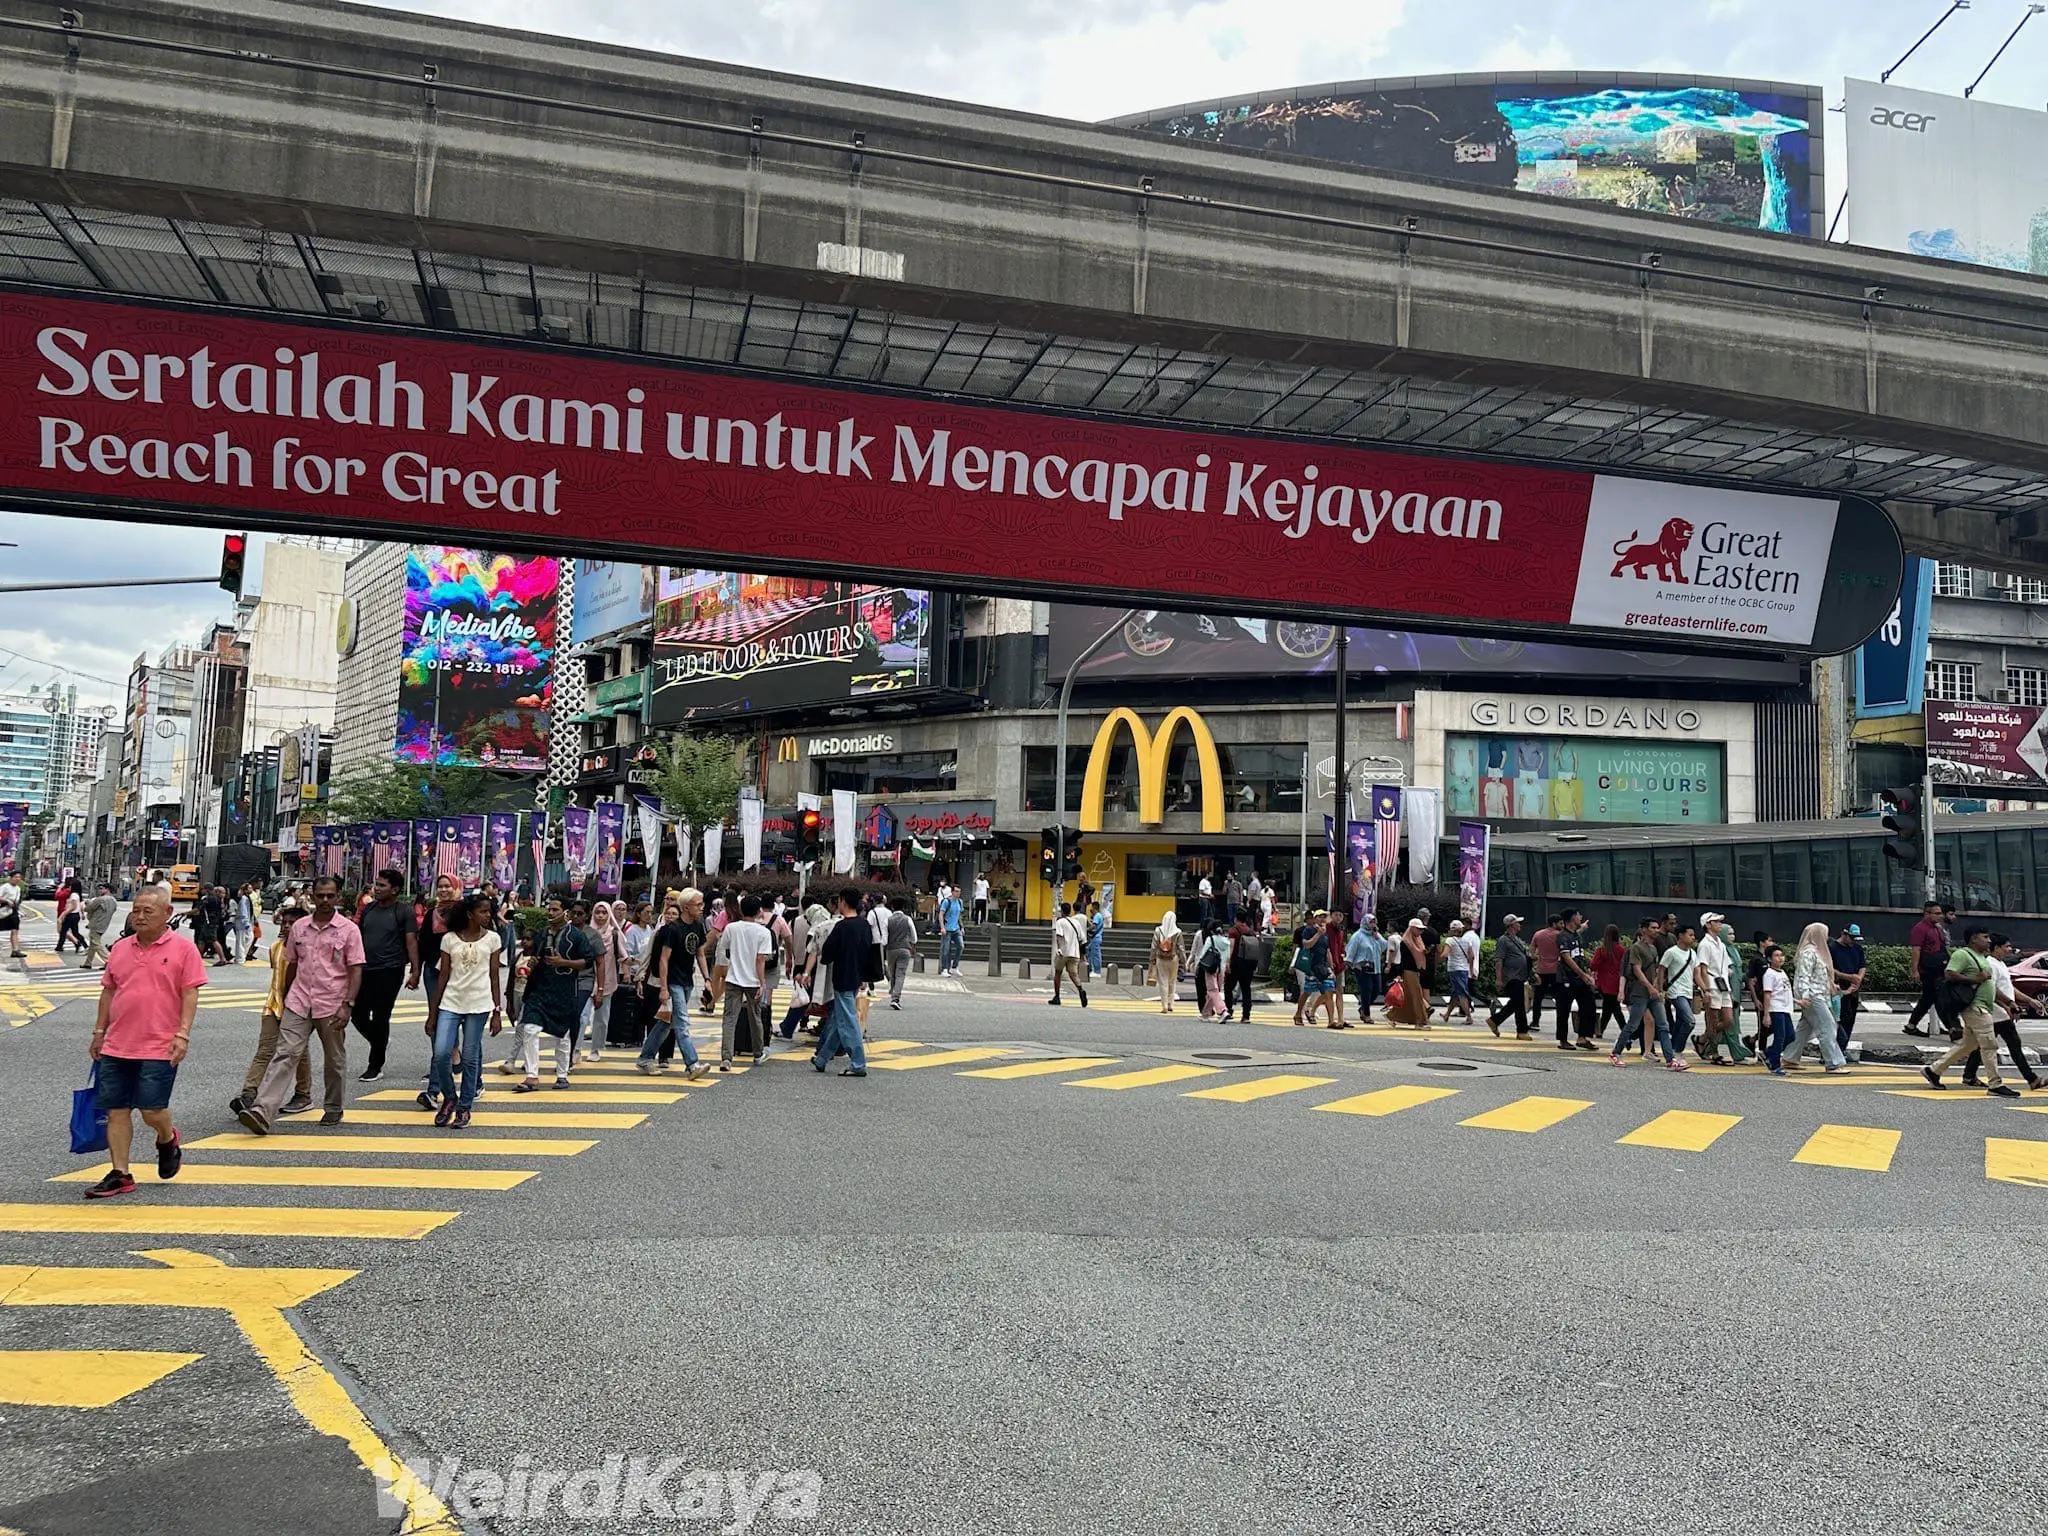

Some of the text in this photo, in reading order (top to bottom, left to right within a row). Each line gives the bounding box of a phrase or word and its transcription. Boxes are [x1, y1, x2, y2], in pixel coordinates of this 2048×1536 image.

[1870, 106, 1936, 133] acer
[37, 326, 1503, 544] Sertailah Kami untuk Mencapai Kejayaan
[38, 415, 562, 516] Reach for Great
[1701, 521, 1783, 559] Great
[1693, 554, 1800, 595] Eastern
[1656, 591, 1796, 614] A member of the OCBC Group
[419, 609, 538, 643] MediaVibe
[1625, 611, 1768, 635] greateasternlife.com
[664, 620, 865, 682] LED FLOOR & TOWERS
[427, 659, 452, 671] 012
[466, 661, 492, 673] 232
[495, 663, 524, 675] 1813
[1470, 699, 1702, 731] GIORDANO
[807, 733, 894, 756] McDonald's
[1623, 749, 1682, 758] GIORDANO
[1597, 759, 1707, 777] LIVING YOUR
[1598, 775, 1709, 794] COLOURS
